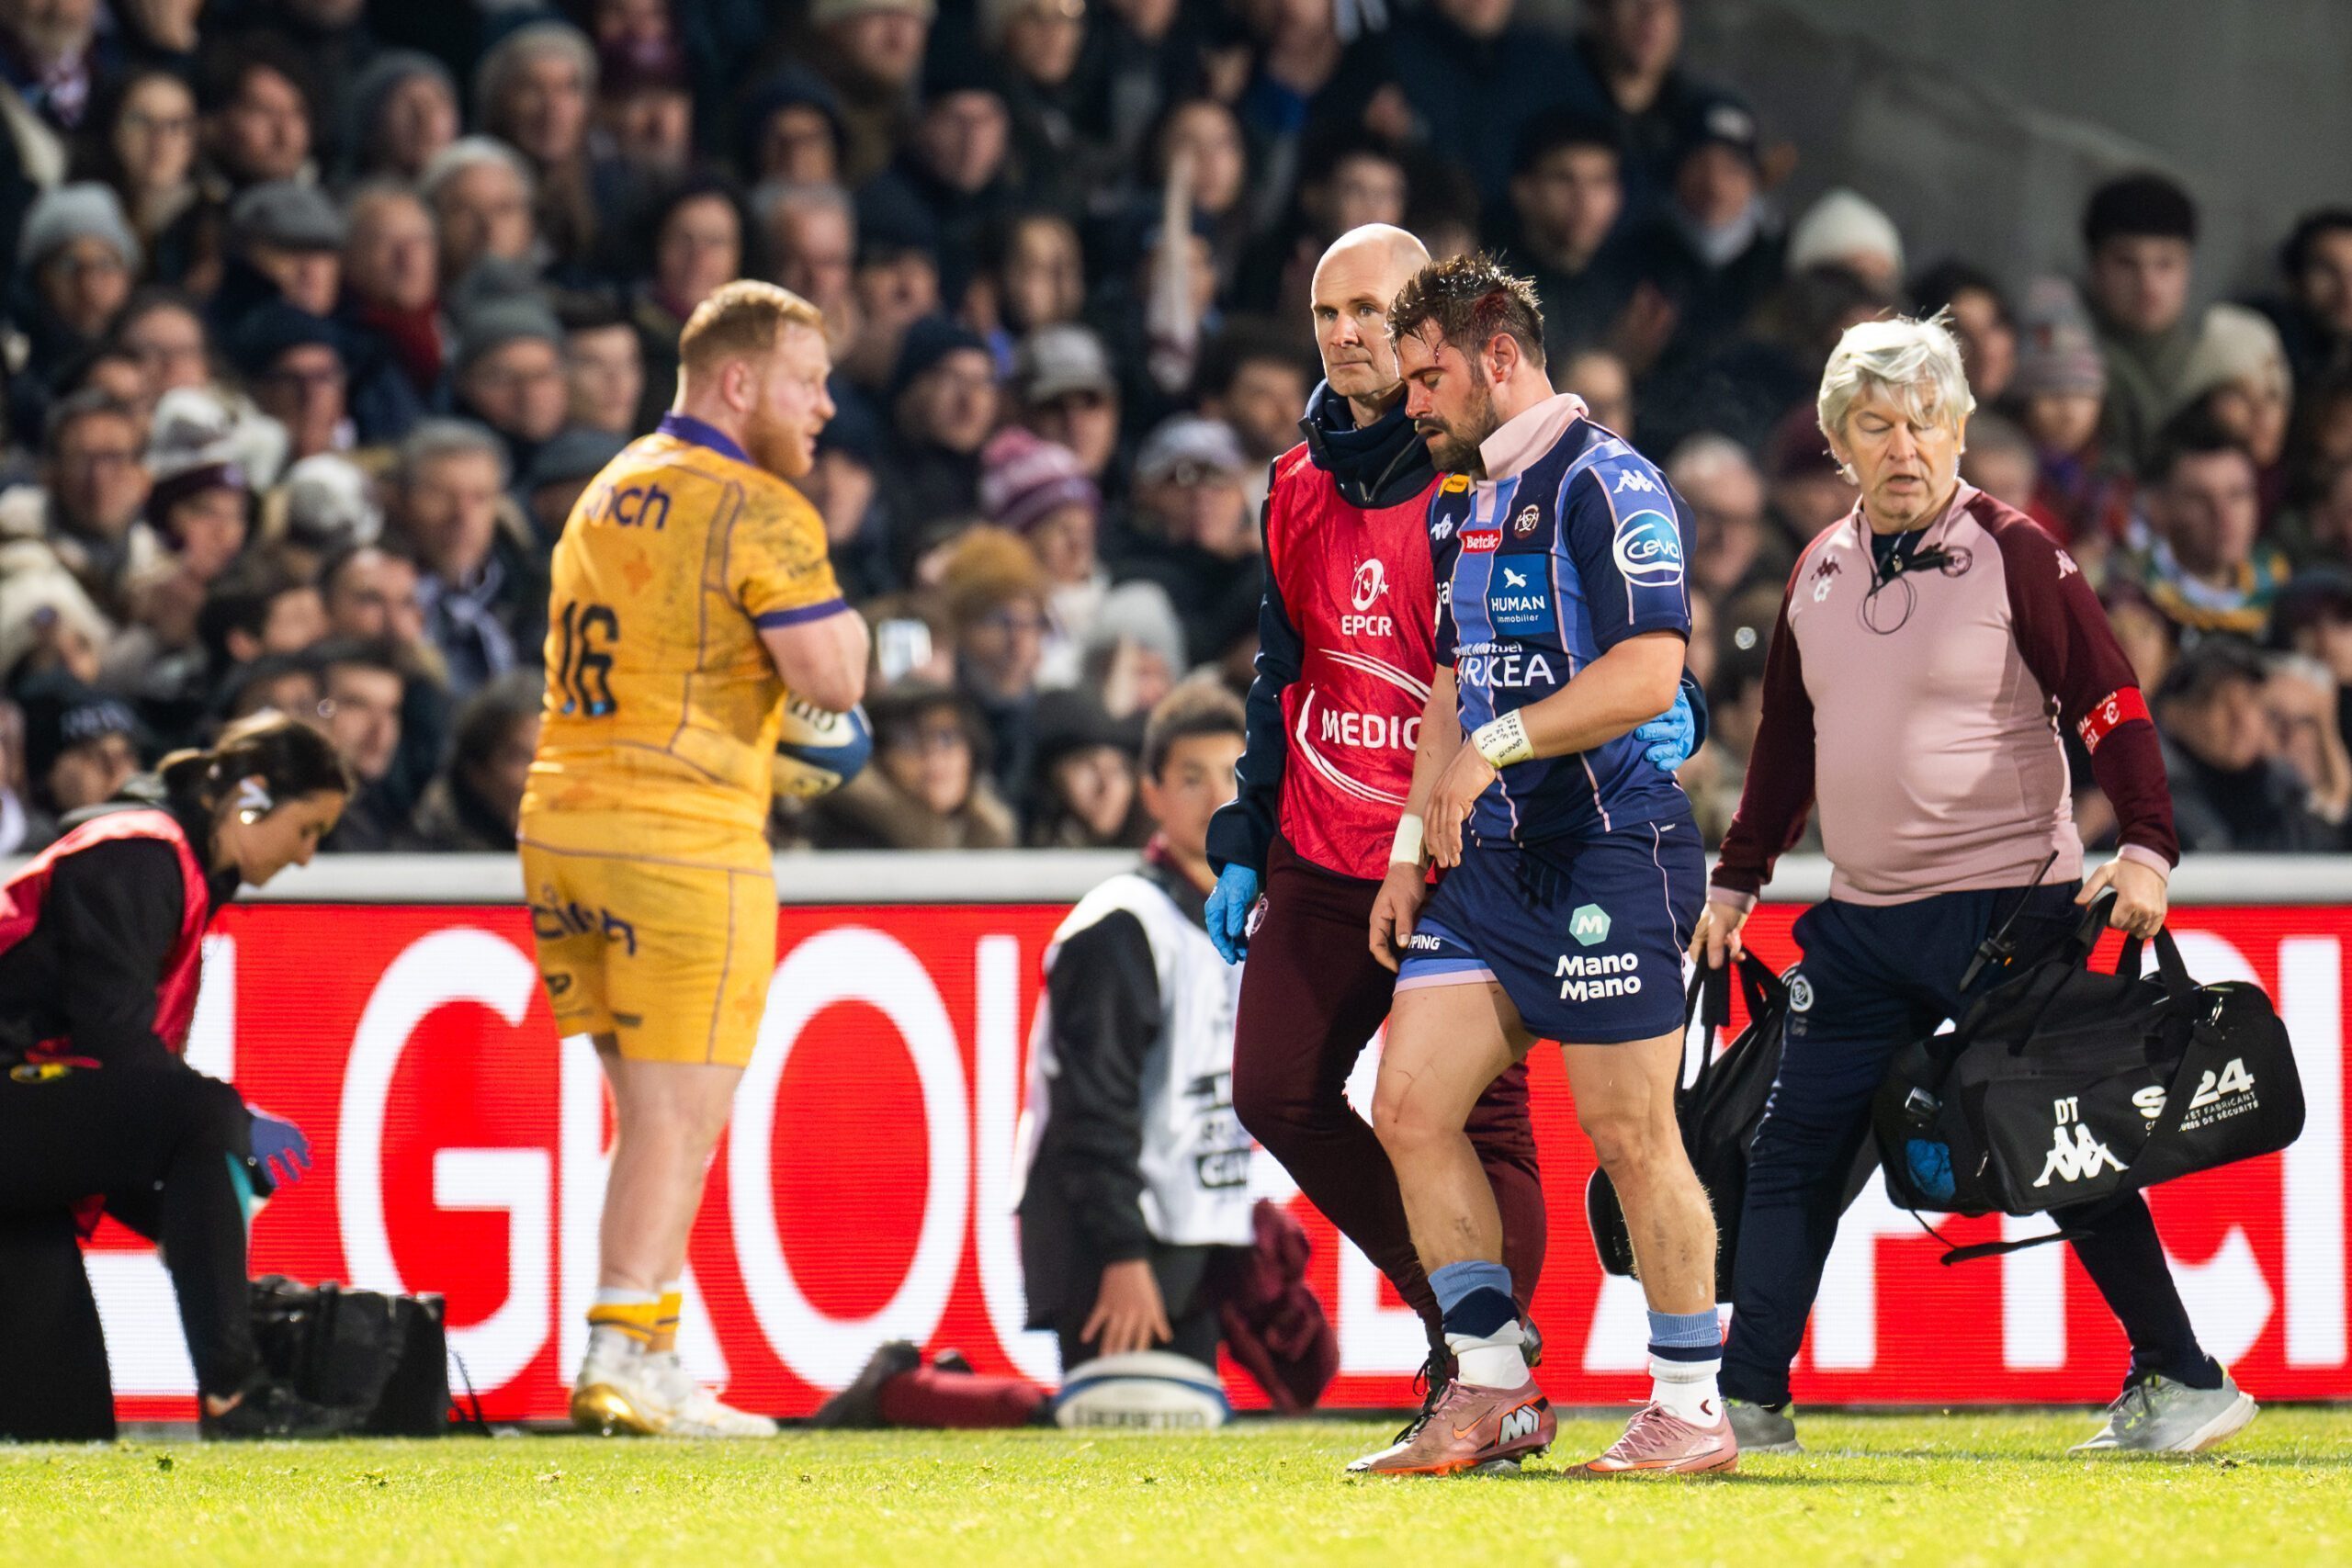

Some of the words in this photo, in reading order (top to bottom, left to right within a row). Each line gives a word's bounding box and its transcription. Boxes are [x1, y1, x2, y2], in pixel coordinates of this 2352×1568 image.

[1466, 535, 1498, 549] Betclic
[1491, 595, 1545, 612] HUMAN
[1341, 615, 1392, 637] EPCR
[560, 602, 619, 716] 16
[1555, 953, 1639, 977] Mano
[1560, 976, 1642, 1002] Mano
[2054, 1097, 2079, 1125] DT
